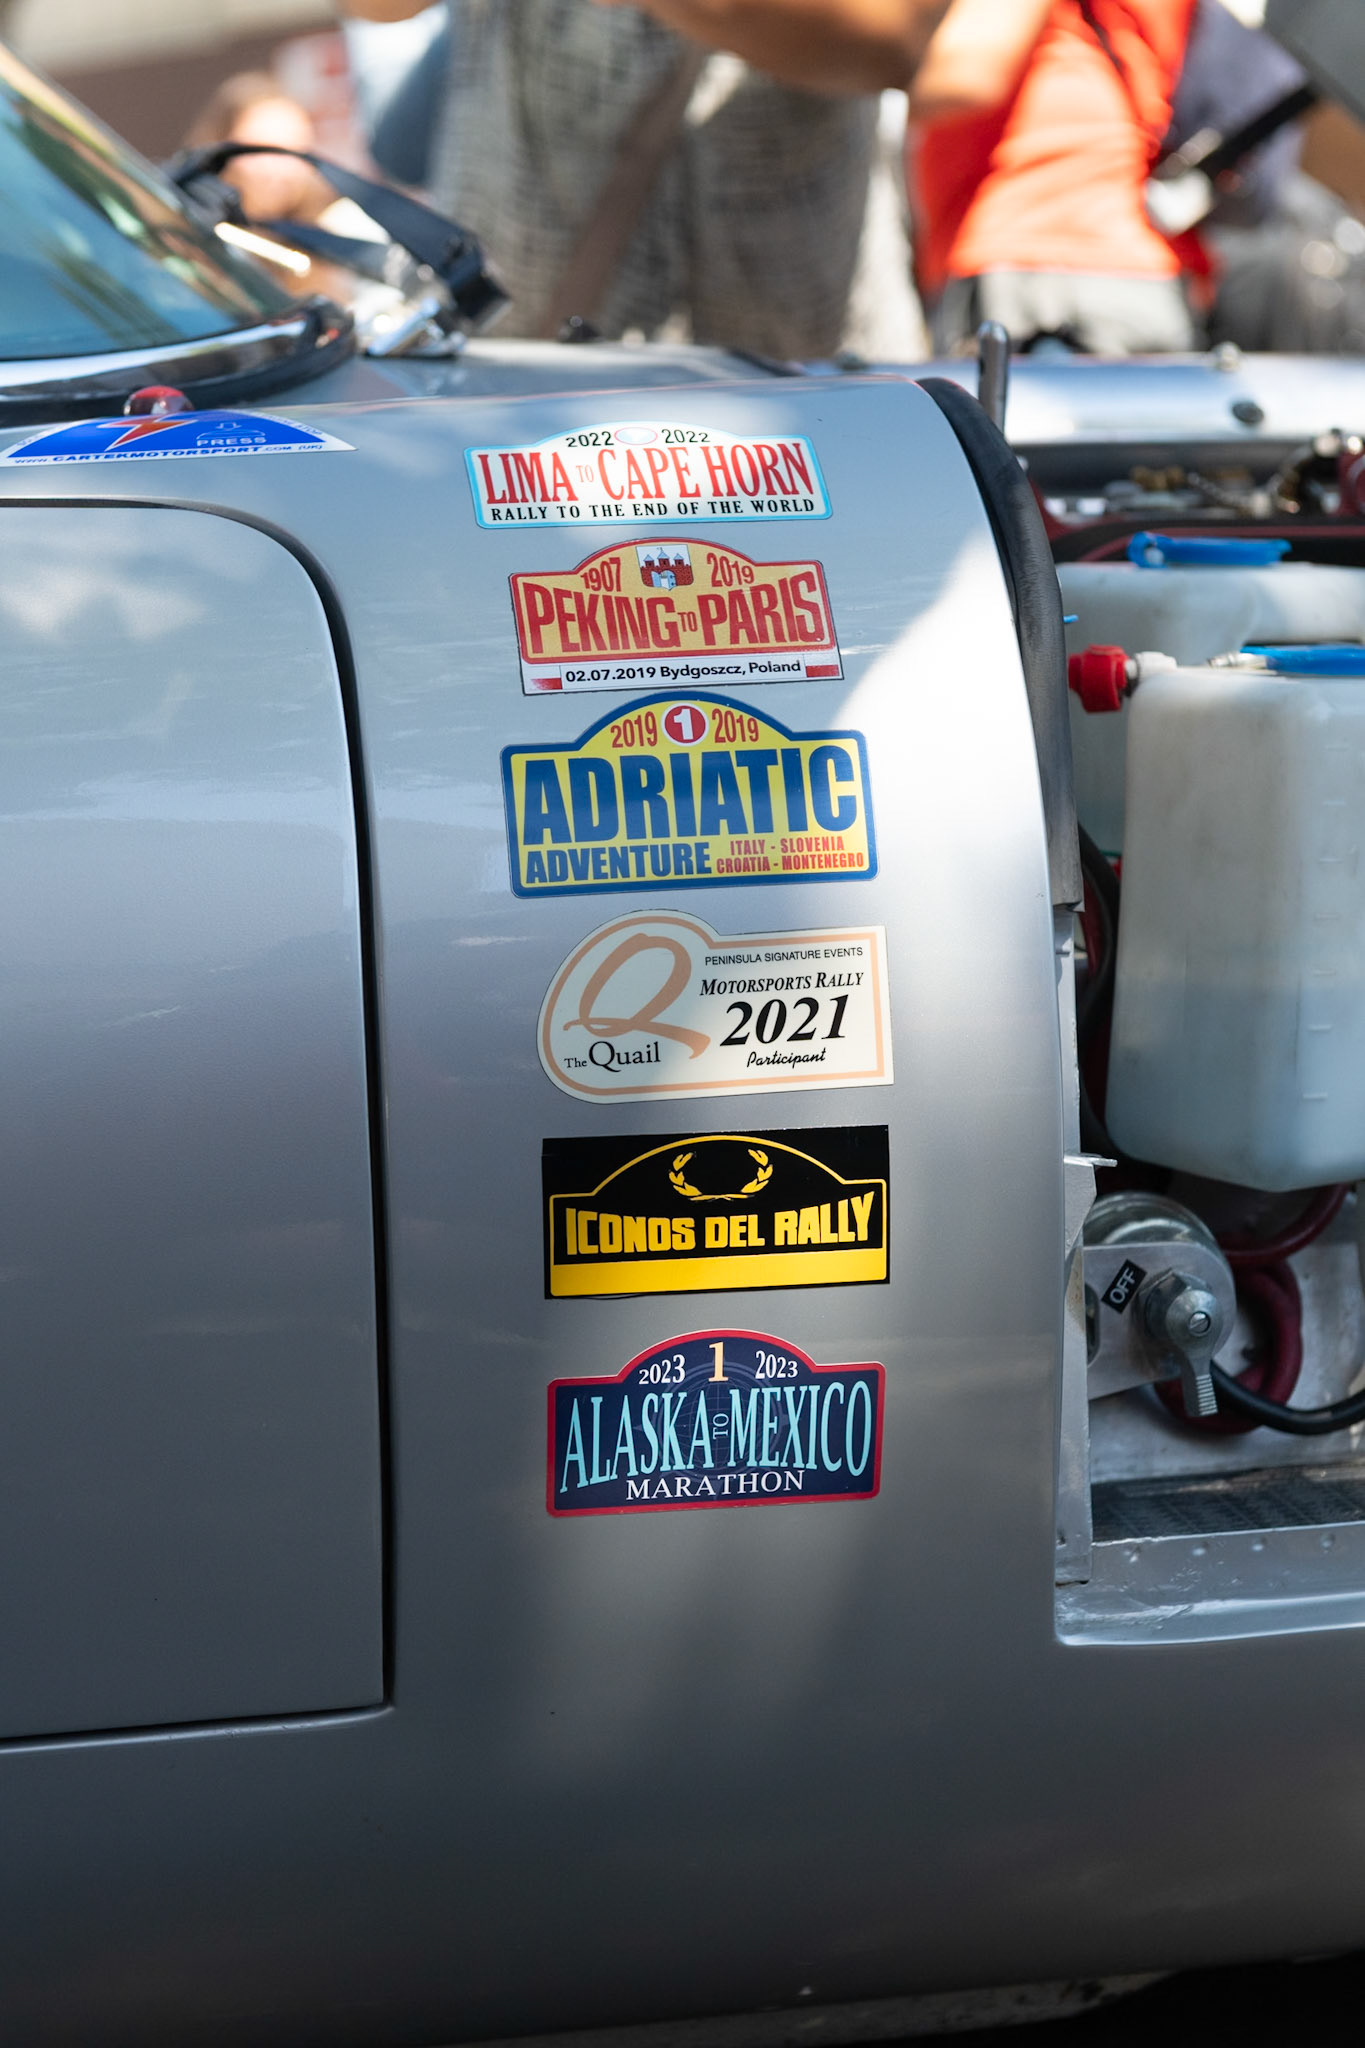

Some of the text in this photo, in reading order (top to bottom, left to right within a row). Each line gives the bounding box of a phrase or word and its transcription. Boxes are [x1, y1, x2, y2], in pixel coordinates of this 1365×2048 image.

[196, 436, 266, 447] PRESS
[565, 429, 710, 447] 2022 2022
[478, 443, 814, 504] LIMA TO CAPE HORN
[491, 499, 815, 521] RALLY TO THE END OF THE WORLD
[580, 552, 755, 592] 1907 2019
[522, 571, 826, 654] PEKING TO PARIS
[565, 660, 801, 682] 02.07.2019 Bydgoszcz, Poland
[611, 708, 759, 748] 2019 1 2019
[523, 745, 857, 845] ADRIATIC
[526, 842, 712, 884] ADVENTURE
[716, 856, 771, 874] CROATIA
[782, 852, 864, 871] MONTENEGRO
[730, 839, 765, 856] ITALY
[780, 836, 845, 853] SLOVENIA
[705, 947, 863, 966] PENINSULA SIGNATURE EVENTS
[700, 971, 864, 996] MOTORSPORTS RALLY
[720, 994, 849, 1047] 2021
[564, 1040, 661, 1072] The Quail
[747, 1047, 827, 1069] Participant
[565, 1191, 875, 1255] ICONOS DEL RALLY
[1109, 1267, 1136, 1304] OFF
[639, 1341, 798, 1385] 2023 1 2023
[560, 1381, 872, 1493] ALASKA TO MEXICO
[626, 1470, 805, 1500] MARATHON
